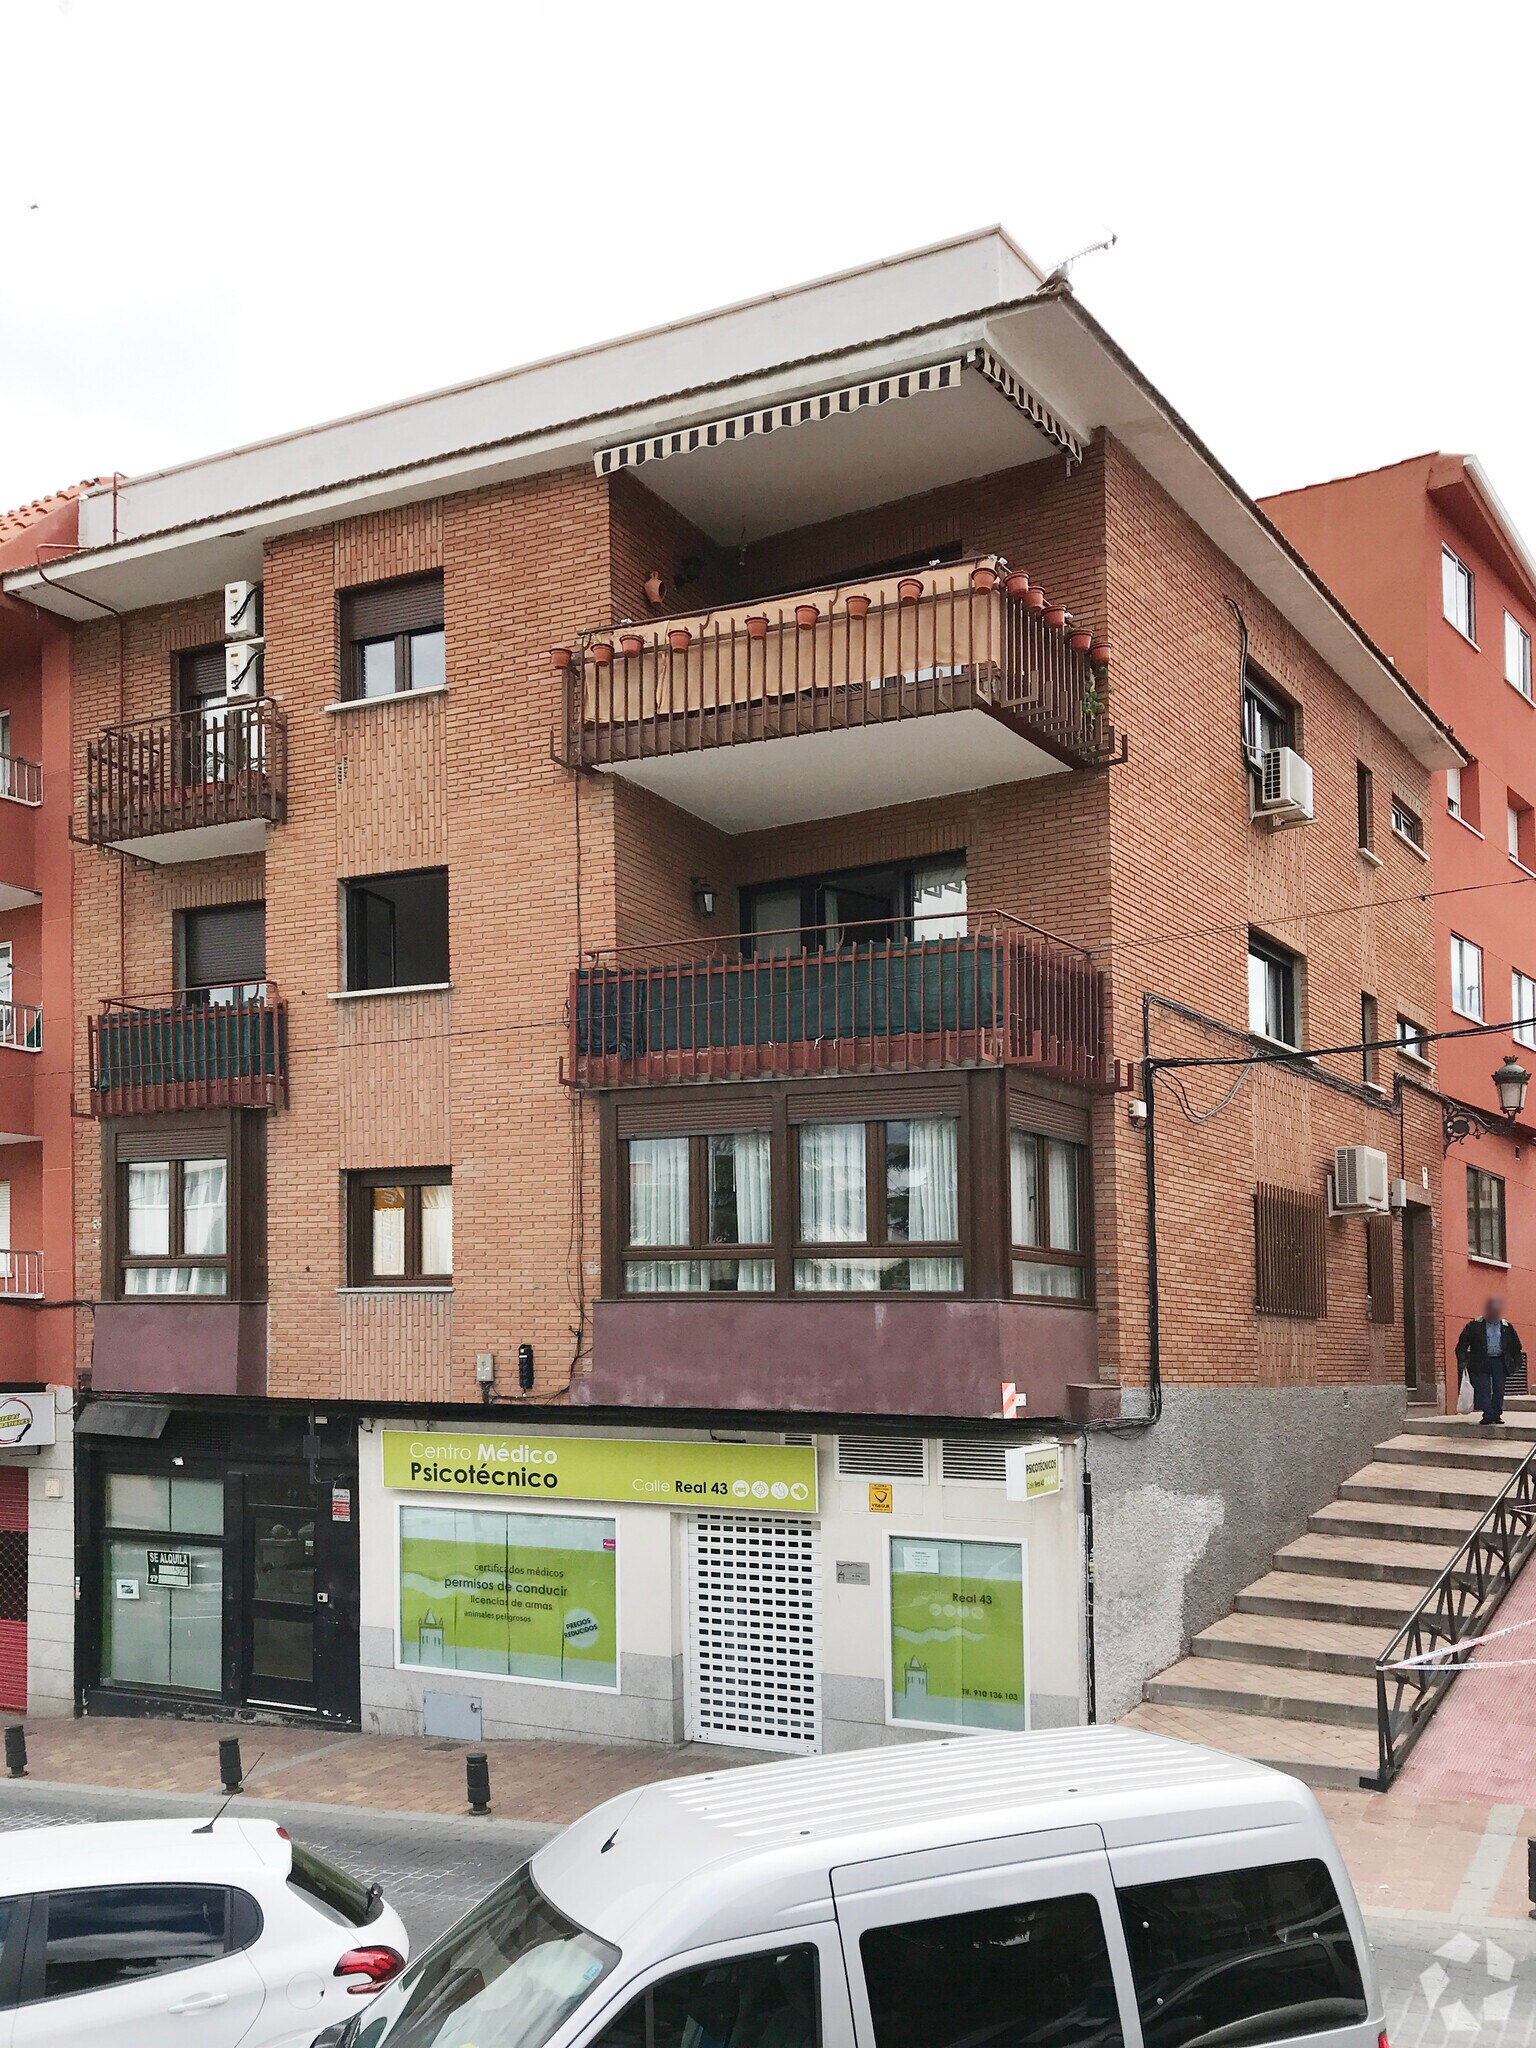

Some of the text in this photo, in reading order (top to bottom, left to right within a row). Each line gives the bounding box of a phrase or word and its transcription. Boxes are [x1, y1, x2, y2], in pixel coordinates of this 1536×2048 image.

[409, 1441, 558, 1464] Centro Médico
[411, 1462, 559, 1489] Psicotécnico
[632, 1478, 729, 1495] Calle Real 43
[149, 1552, 188, 1565] SE ALQUILA
[474, 1563, 564, 1578] certificados médicos
[444, 1578, 568, 1597] permisos de conducir
[470, 1595, 553, 1611] licencias de armas
[952, 1593, 977, 1604] Real
[979, 1594, 993, 1605] 43
[464, 1610, 532, 1623] animales peligrosos
[565, 1617, 591, 1630] PRECIOS
[564, 1623, 598, 1639] REDUCIDOS
[973, 1689, 988, 1698] 910
[989, 1691, 1003, 1699] 136
[1005, 1692, 1018, 1701] 103
